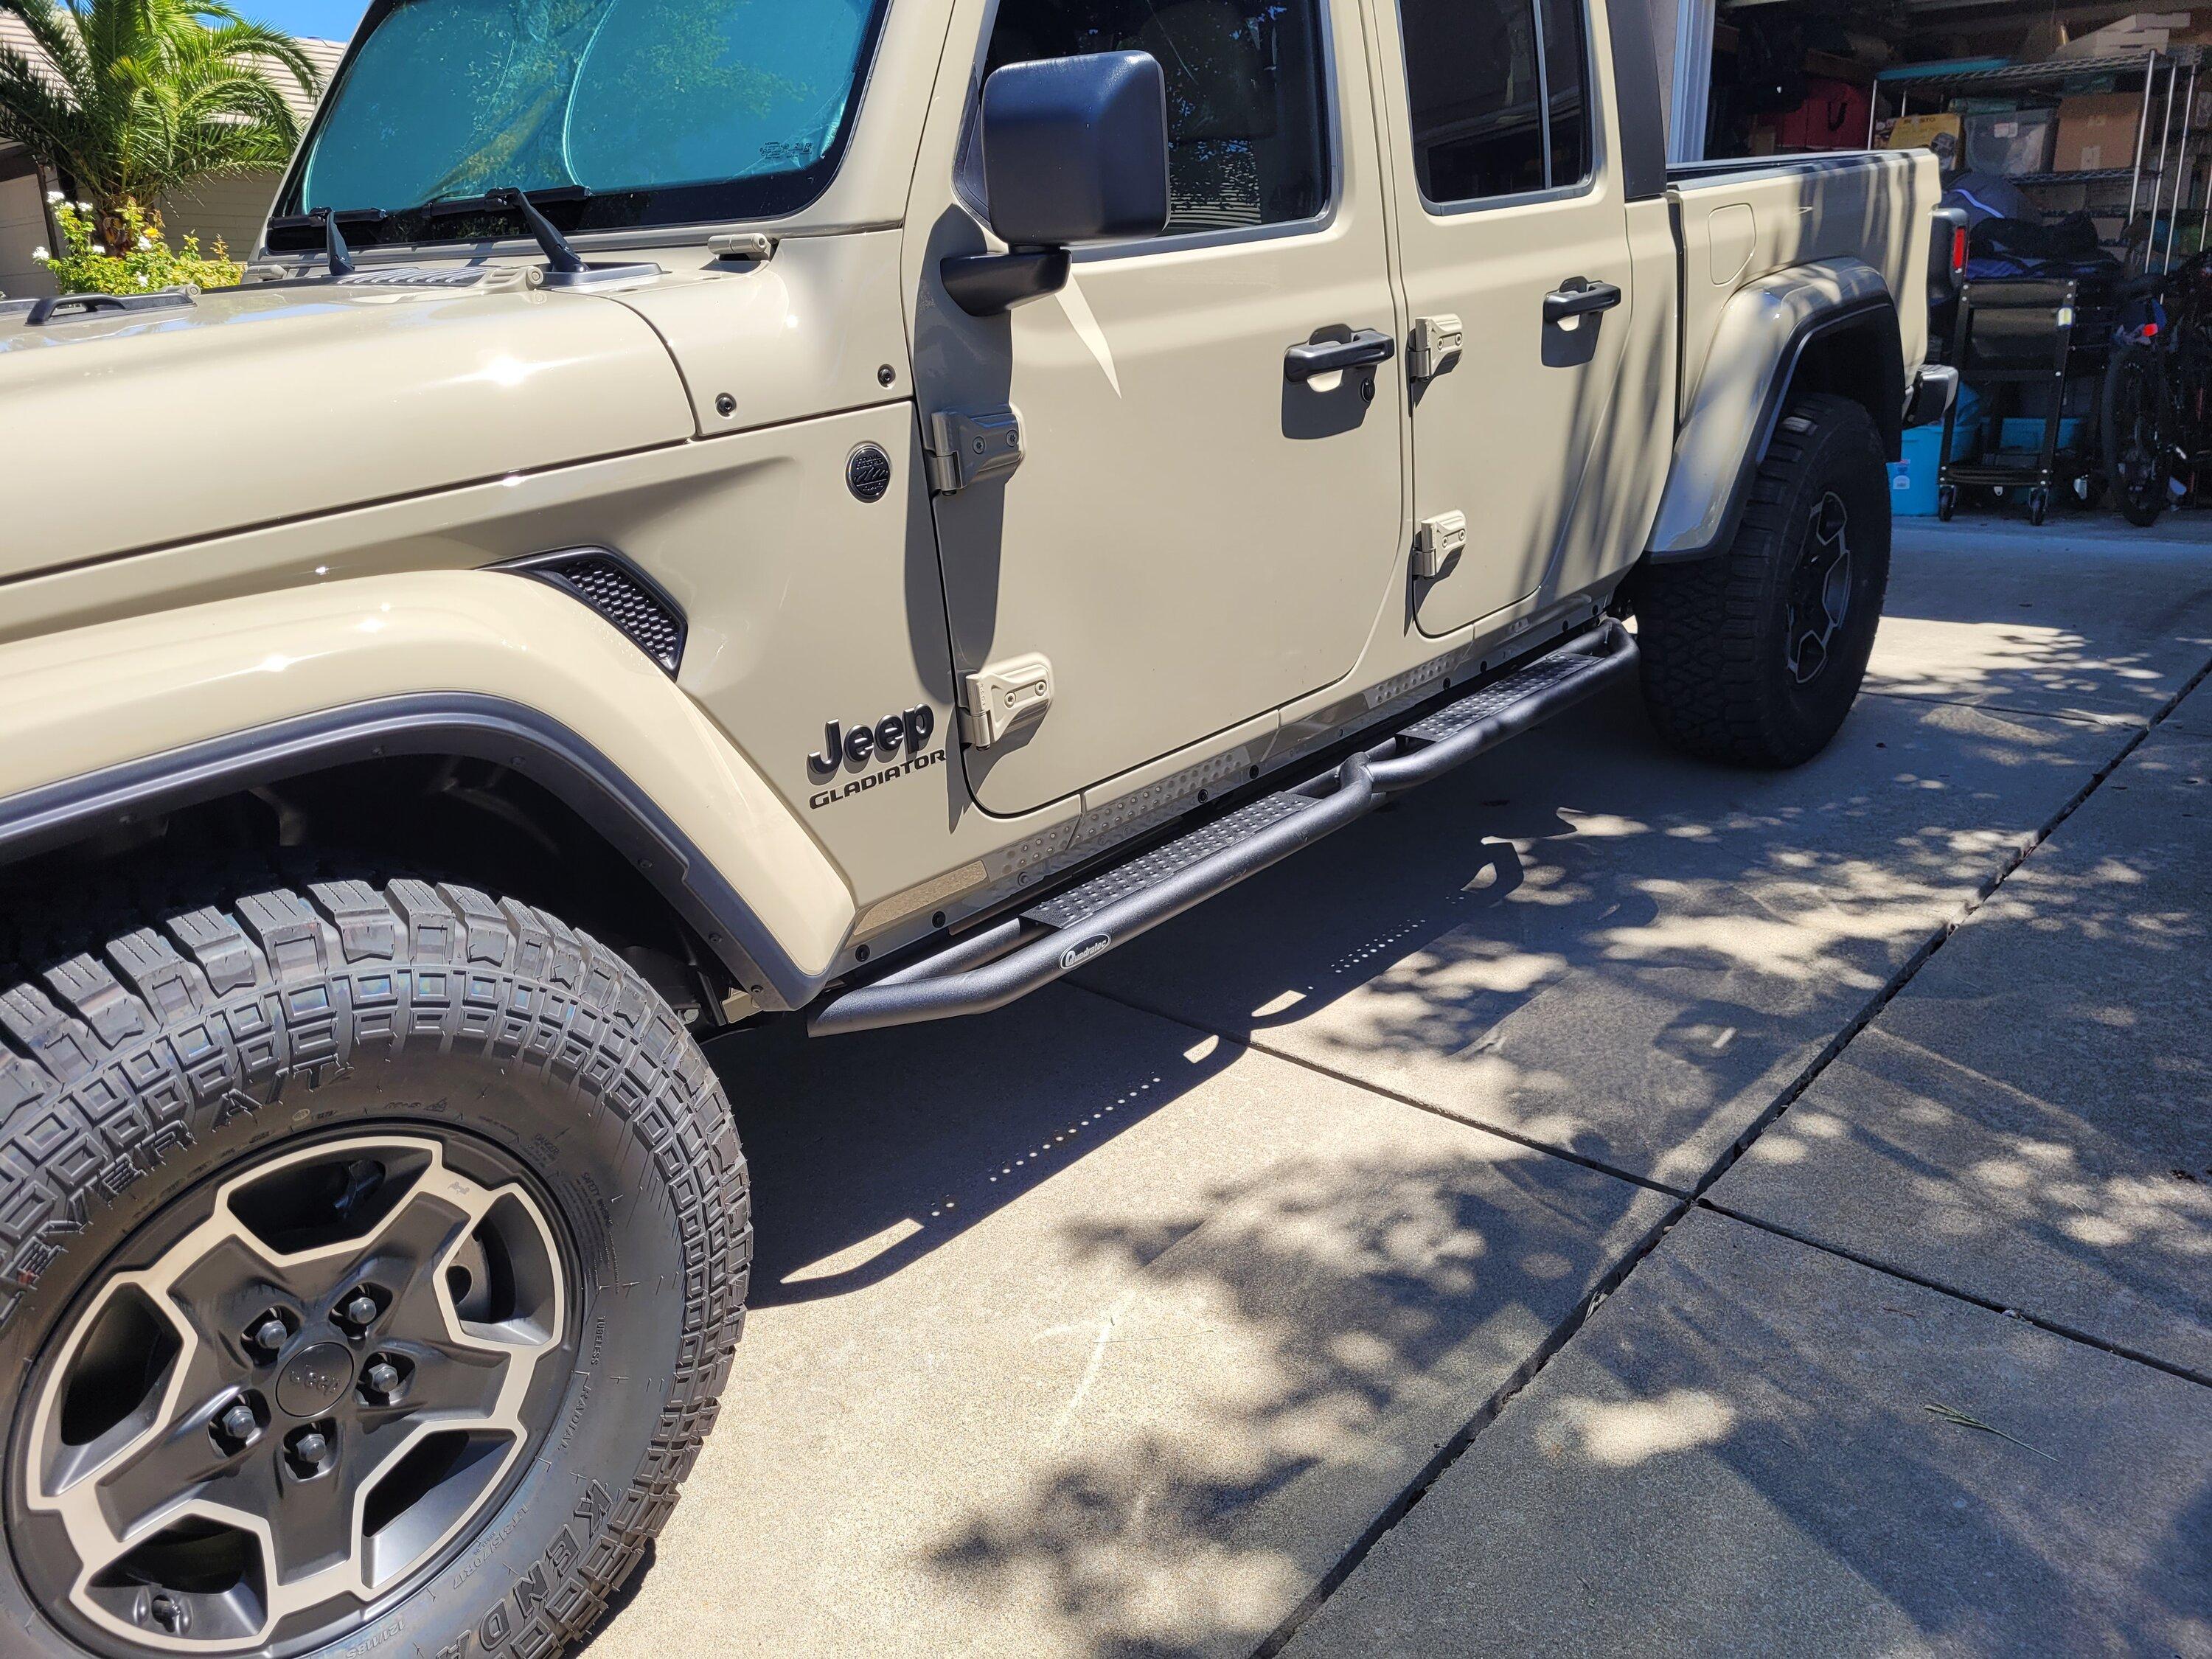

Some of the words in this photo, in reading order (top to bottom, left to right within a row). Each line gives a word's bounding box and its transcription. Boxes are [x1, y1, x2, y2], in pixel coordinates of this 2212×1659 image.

[807, 703, 934, 774] Jeep
[809, 749, 947, 810] GLADIATOR
[1065, 939, 1107, 967] Quadratec
[591, 1315, 606, 1365] TUBELESS
[556, 1385, 591, 1451] RADIAL
[345, 1618, 405, 1659] 121/118S
